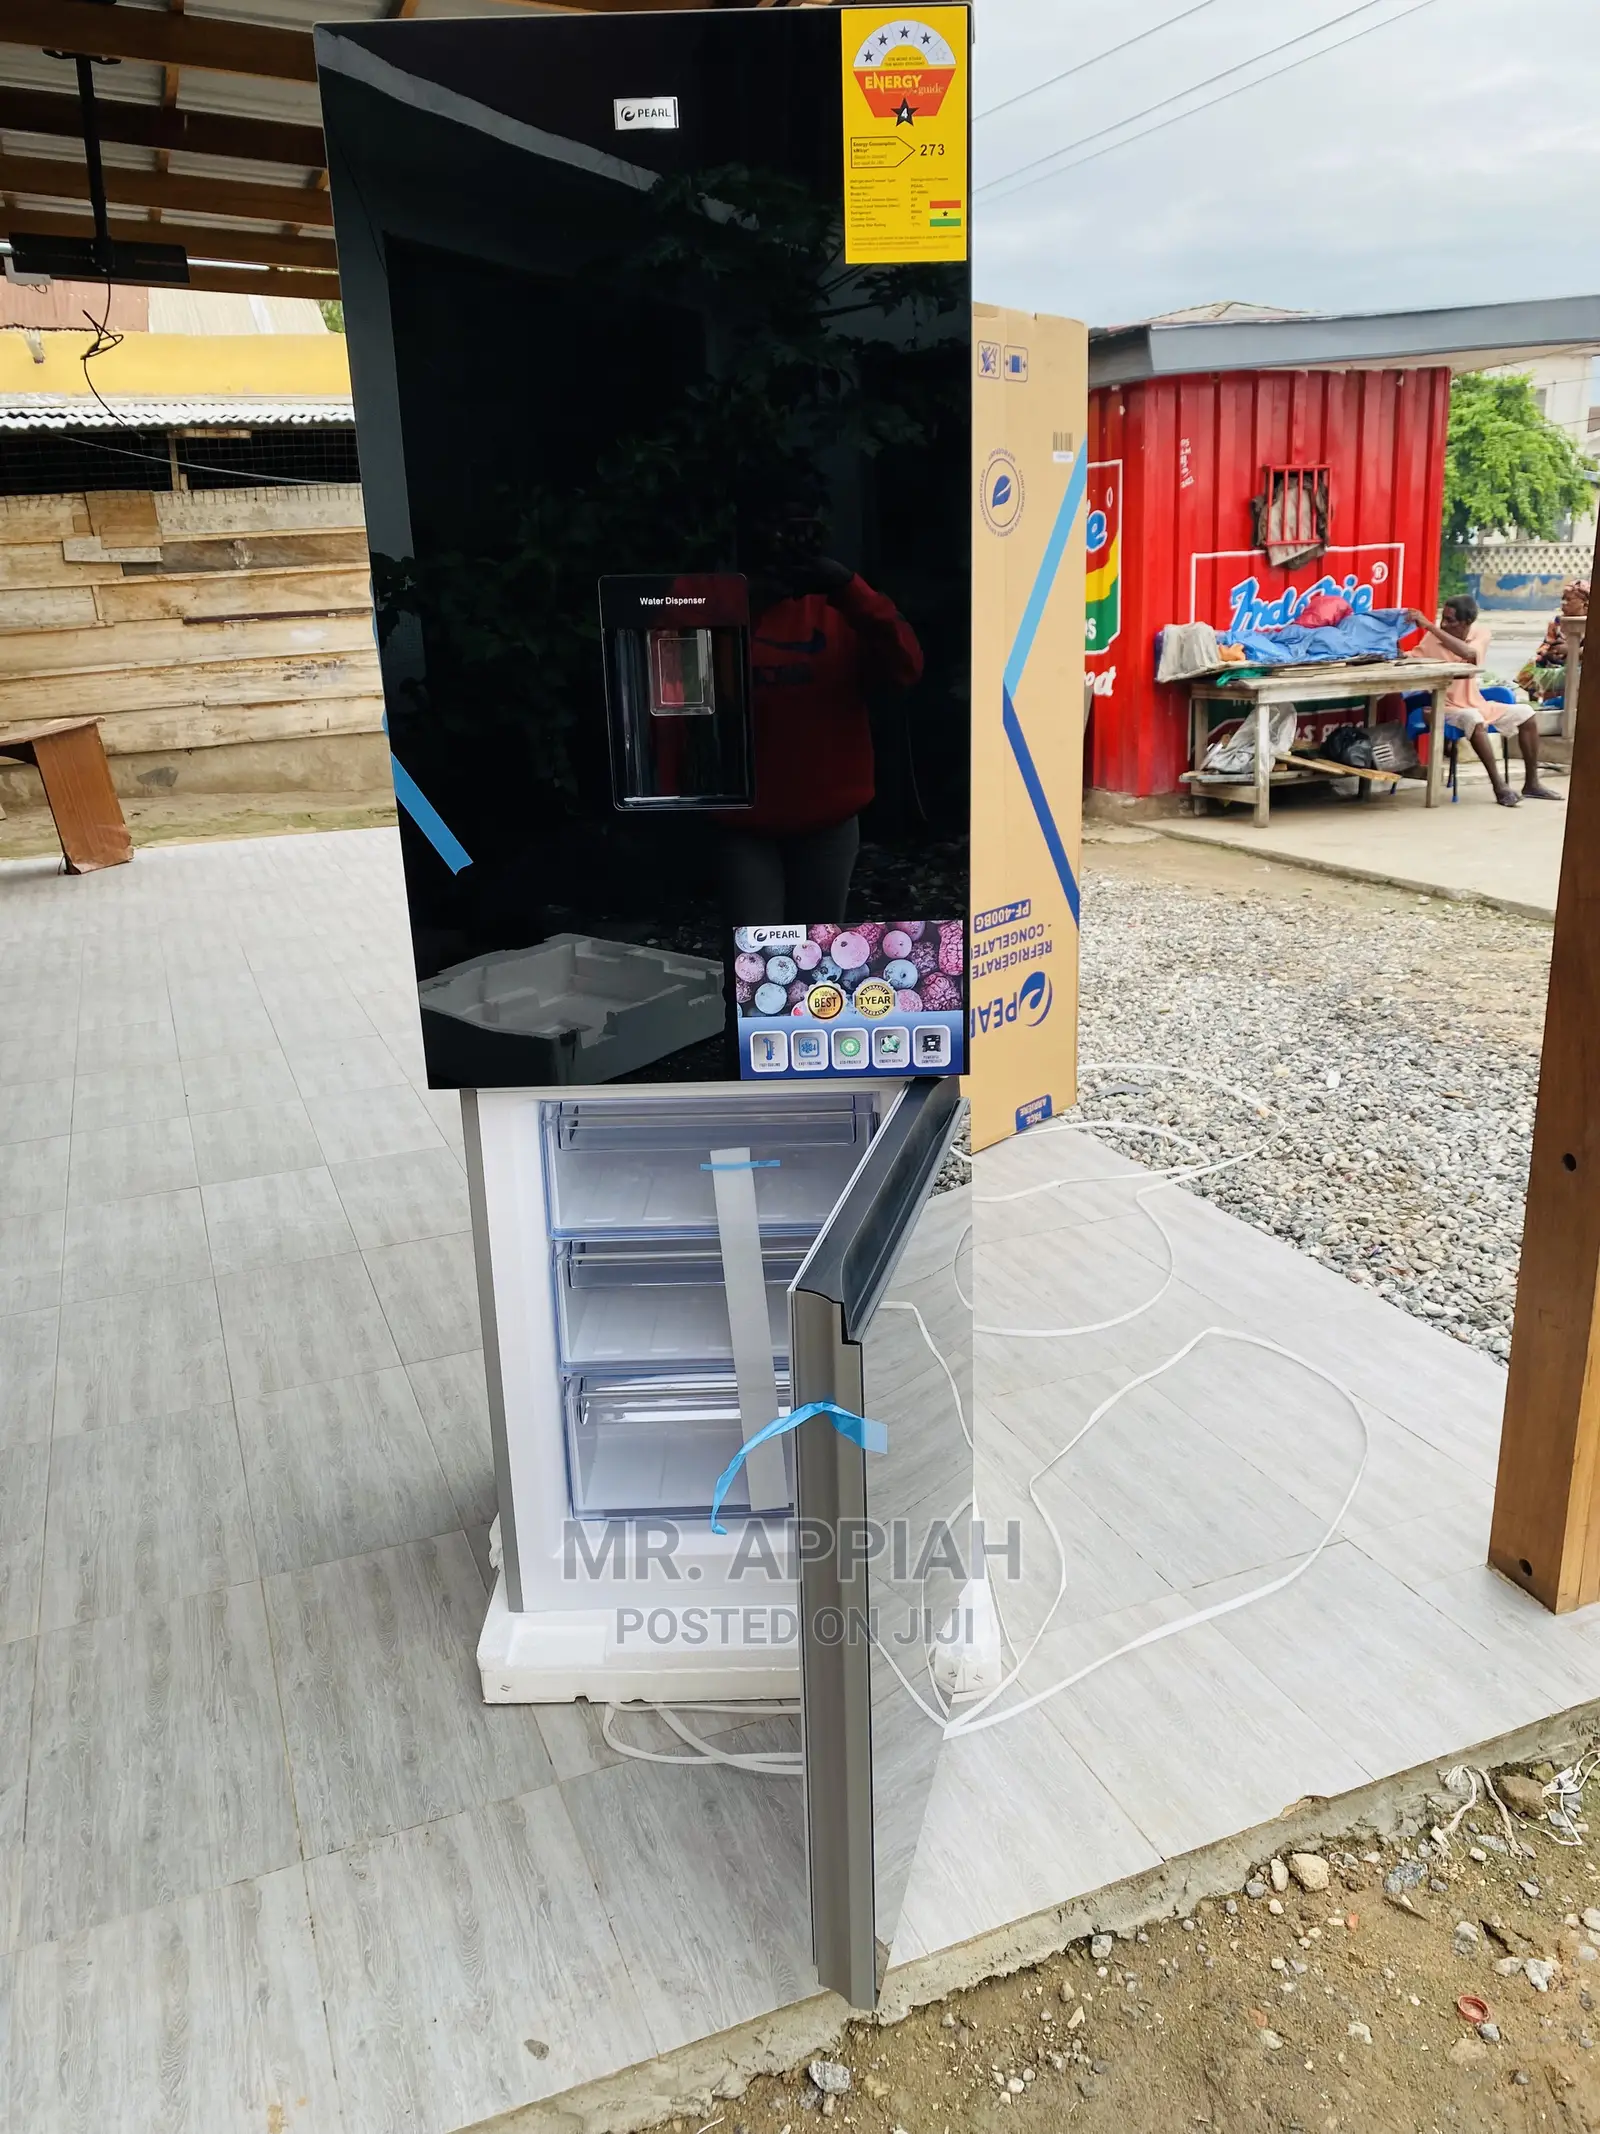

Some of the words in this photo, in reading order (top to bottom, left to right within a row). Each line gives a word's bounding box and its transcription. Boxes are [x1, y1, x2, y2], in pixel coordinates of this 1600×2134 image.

[865, 72, 922, 94] ENERGY
[918, 83, 944, 96] guide
[637, 108, 671, 118] PEARL
[901, 107, 909, 119] 4
[920, 143, 945, 156] 273
[639, 597, 664, 605] Water
[665, 596, 706, 606] Dispenser
[975, 901, 1030, 931] PF-400BG
[769, 930, 801, 939] PEARL
[814, 996, 837, 1008] BEST
